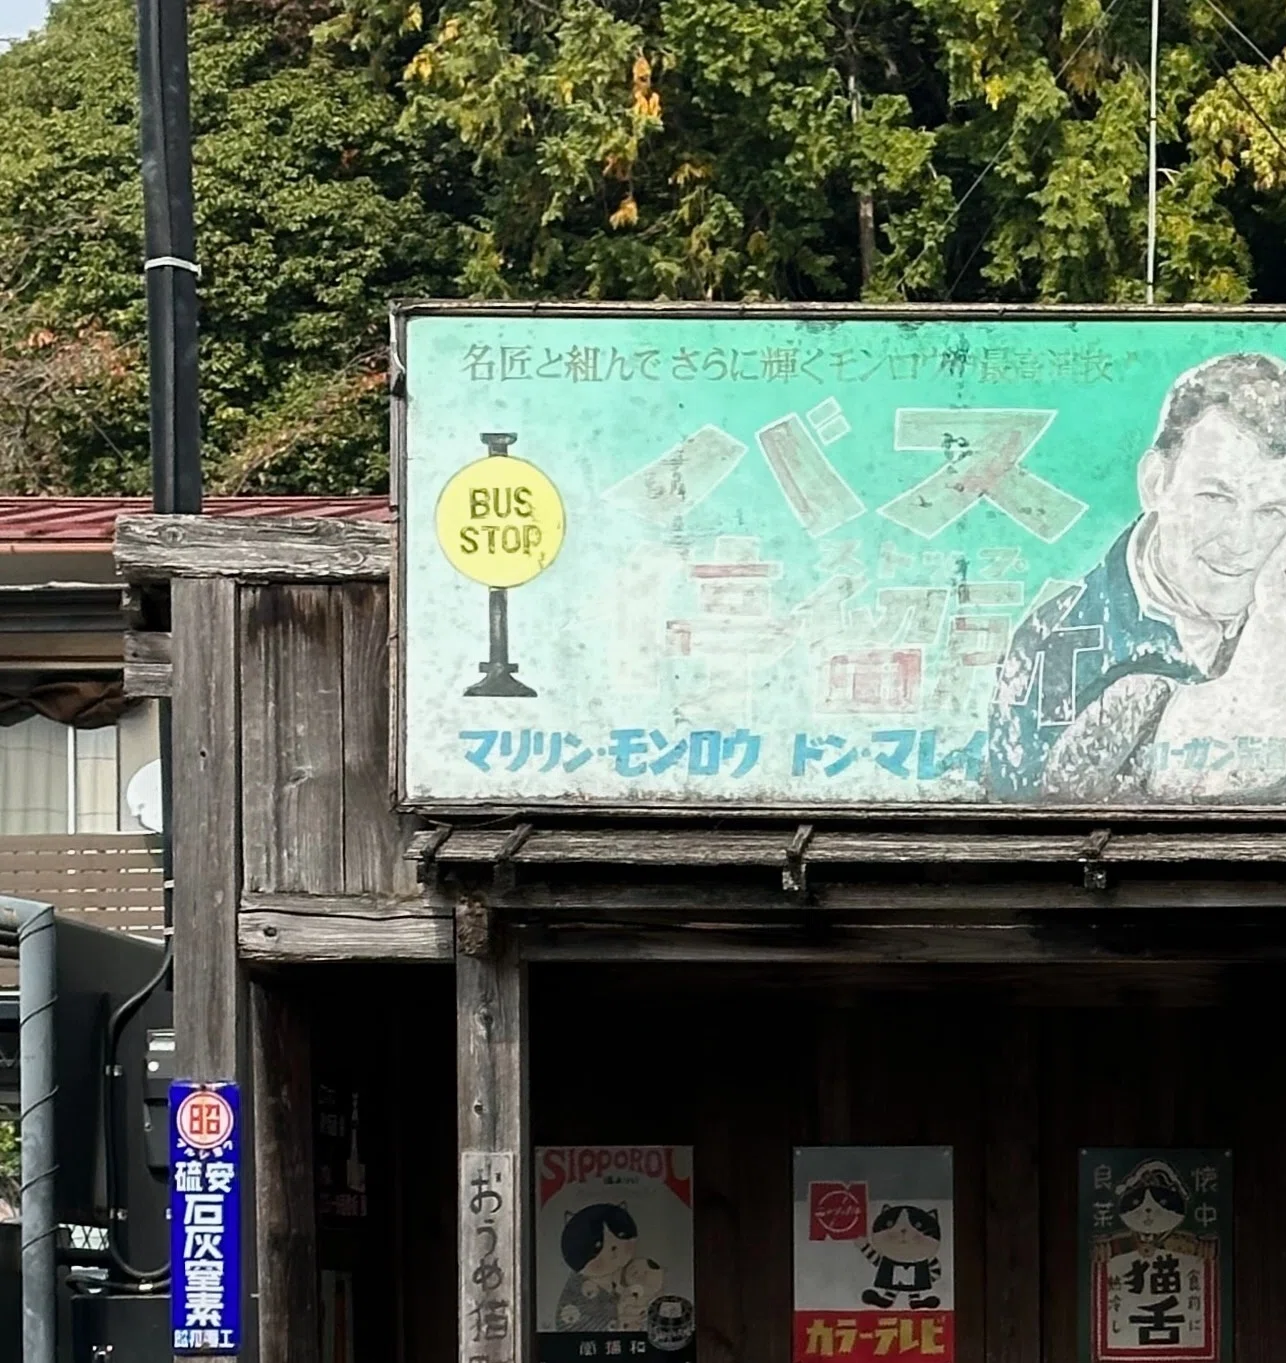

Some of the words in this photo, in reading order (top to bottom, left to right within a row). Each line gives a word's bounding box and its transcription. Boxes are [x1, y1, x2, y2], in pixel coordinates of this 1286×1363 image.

[469, 486, 535, 520] BUS
[459, 523, 542, 556] STOP
[459, 727, 761, 779] マリリン・モンロウ
[188, 1103, 221, 1136] 昭
[174, 1161, 235, 1193] 硫安
[183, 1194, 225, 1328] 石灰窒素
[1123, 1254, 1186, 1347] 猫舌
[805, 1316, 946, 1358] カラーテレビ
